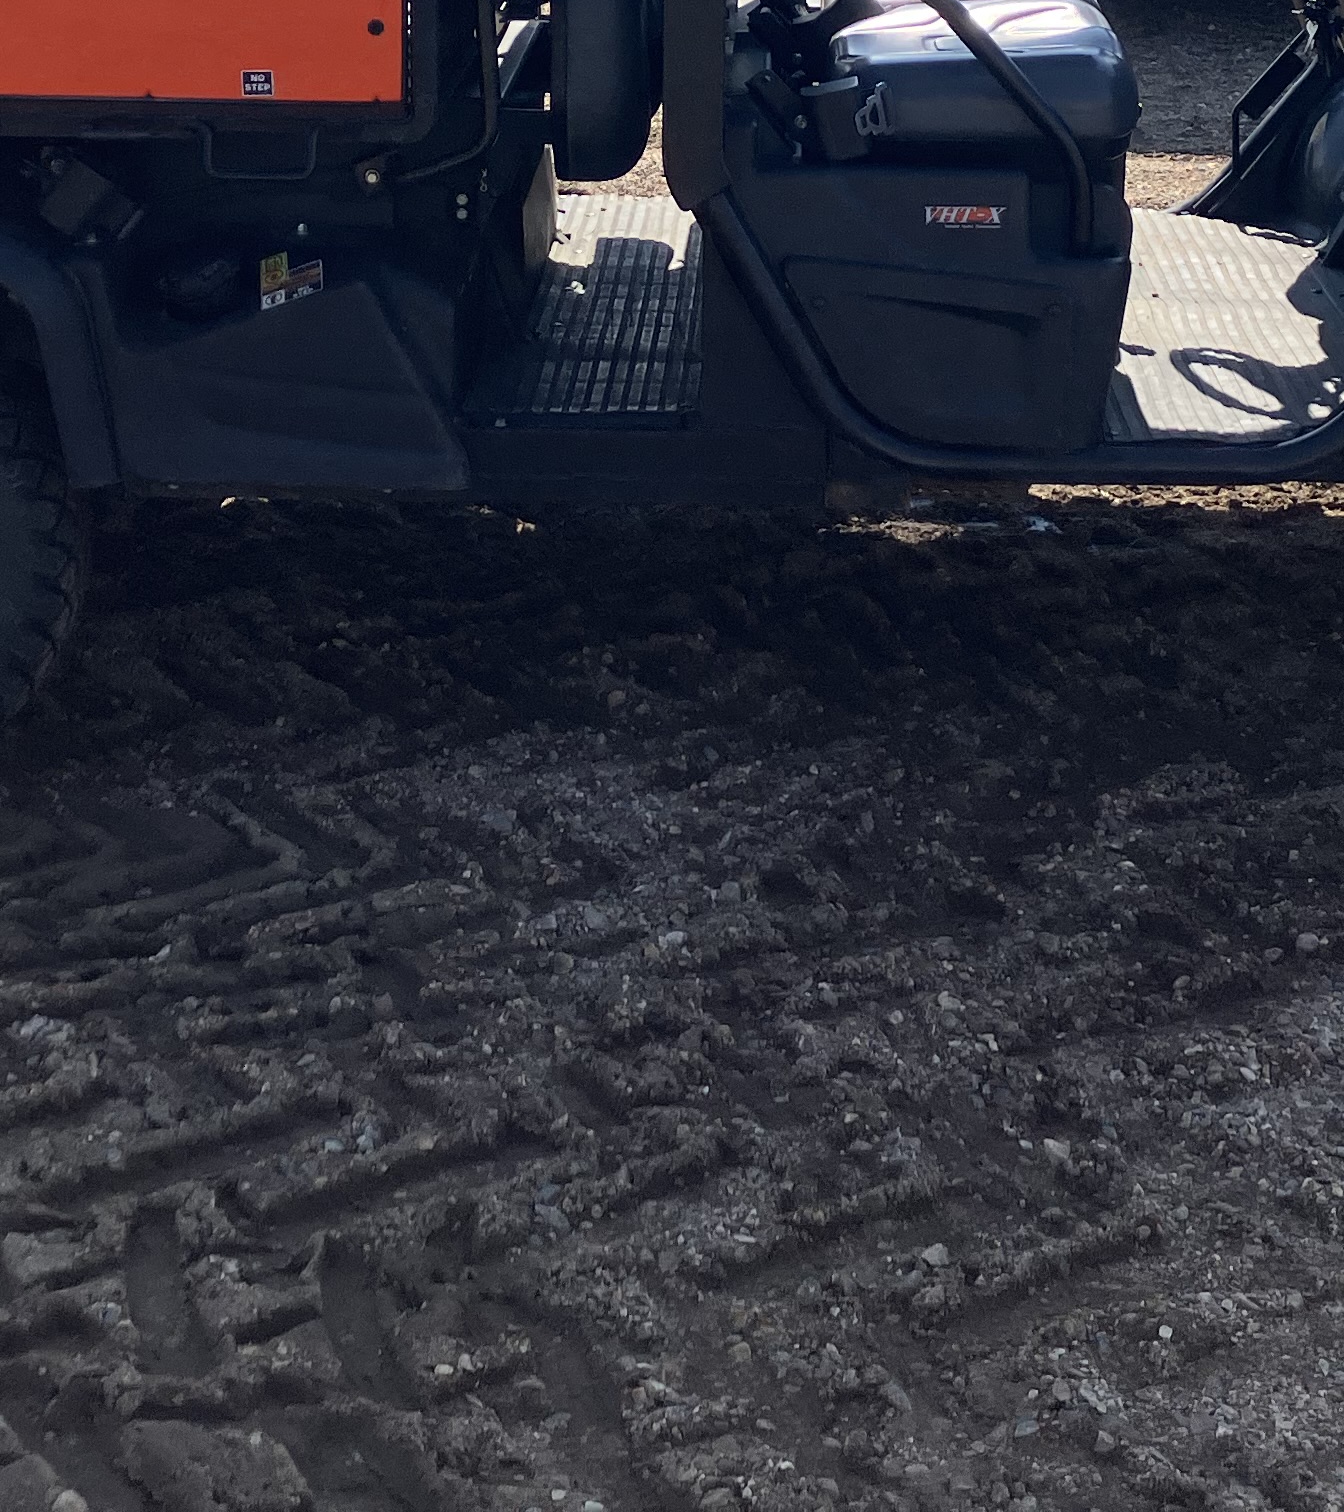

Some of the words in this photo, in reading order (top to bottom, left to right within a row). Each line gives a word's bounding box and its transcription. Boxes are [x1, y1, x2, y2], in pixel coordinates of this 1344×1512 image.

[250, 74, 265, 82] NO
[244, 83, 271, 92] STEP
[924, 206, 1008, 226] VHT-X
